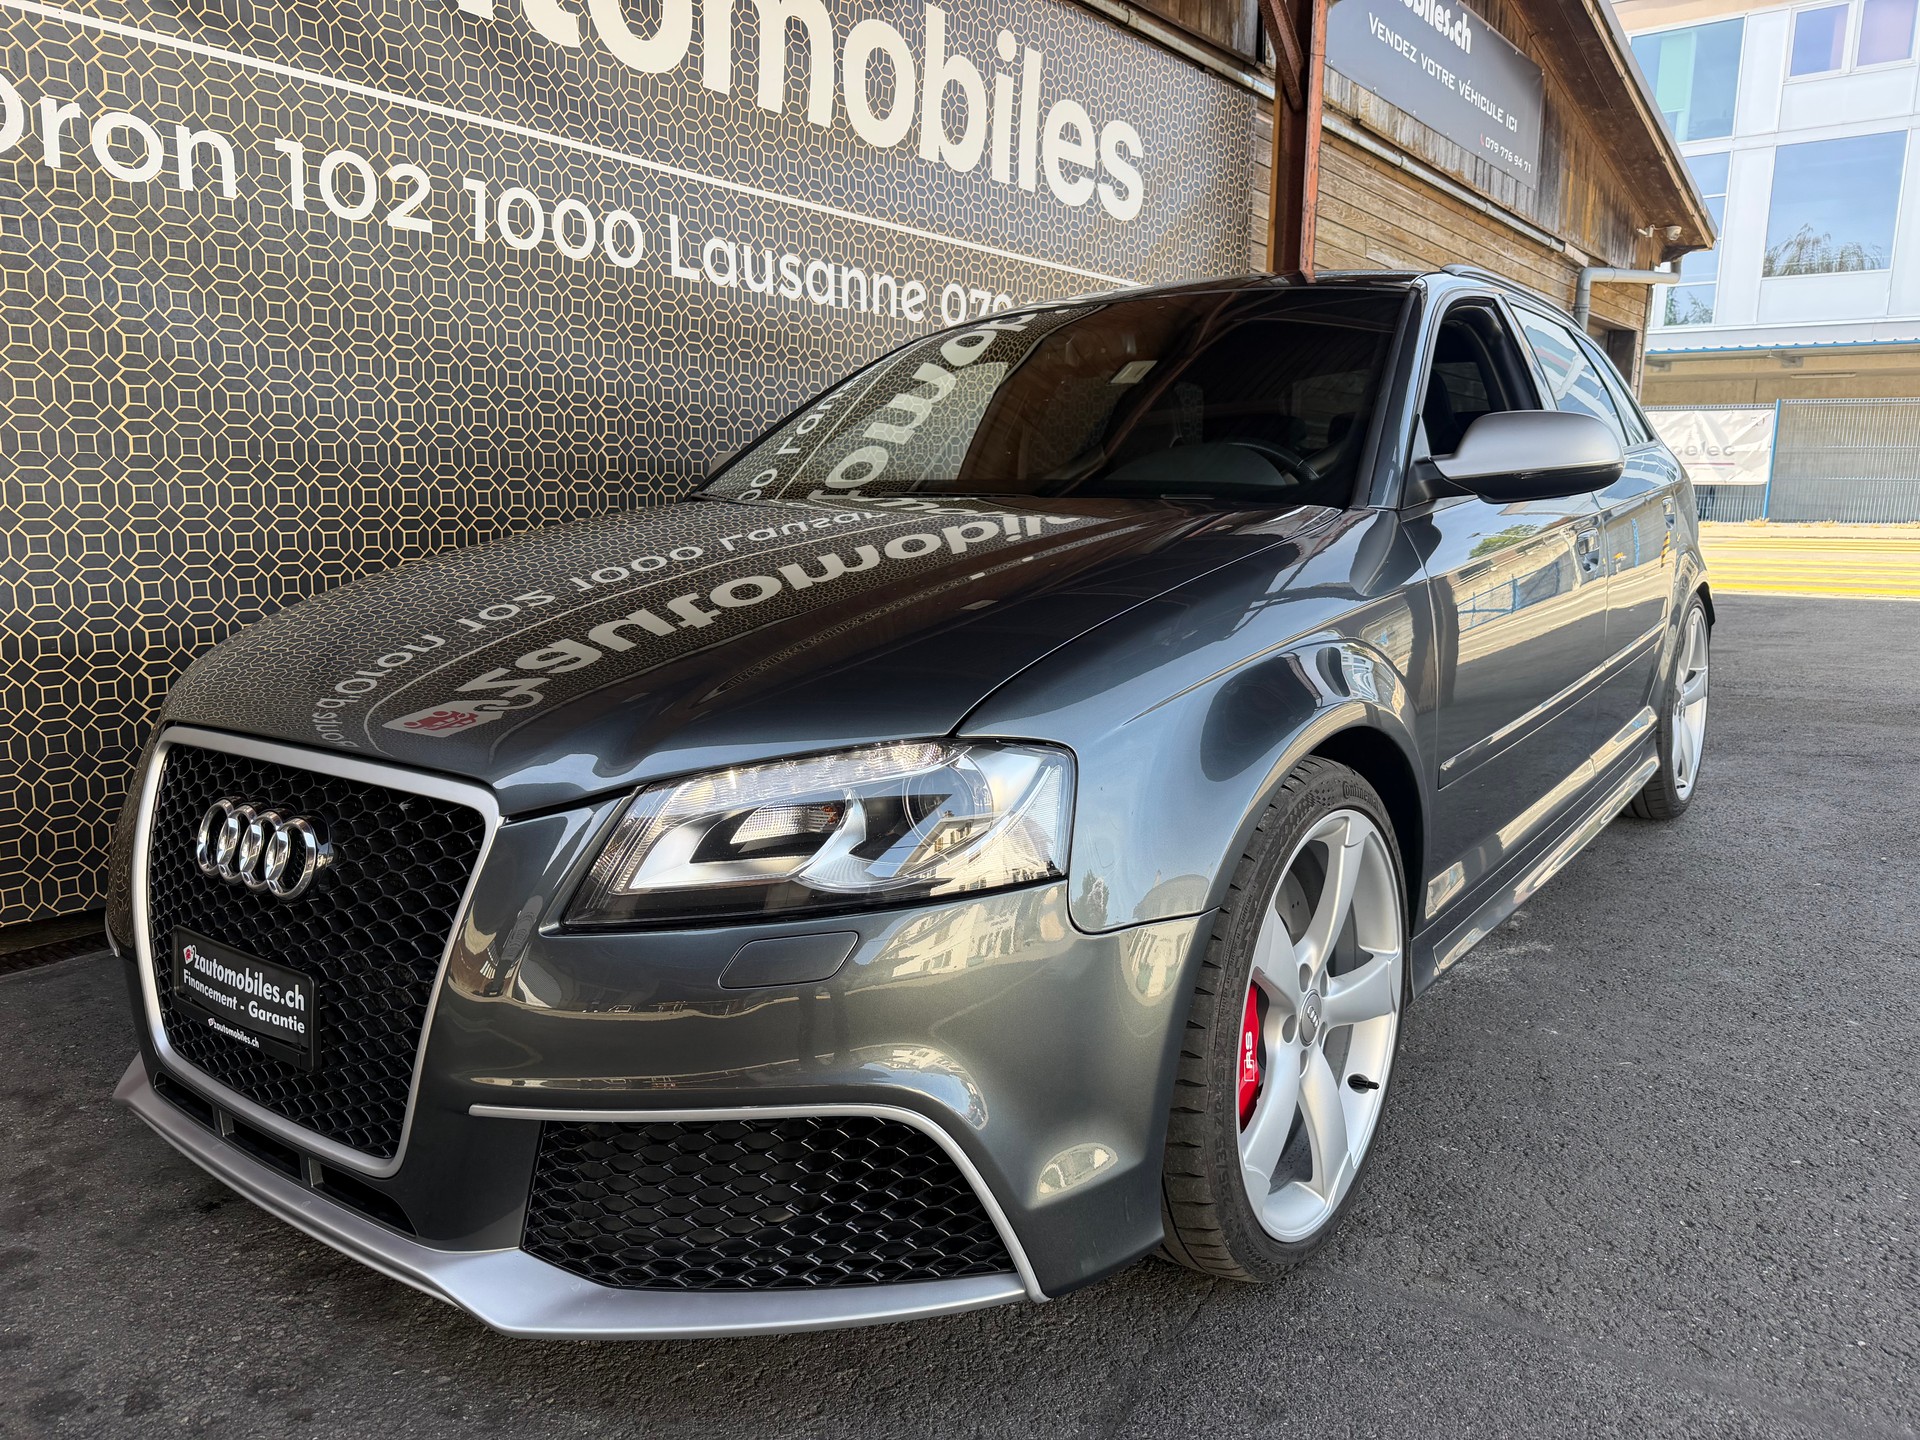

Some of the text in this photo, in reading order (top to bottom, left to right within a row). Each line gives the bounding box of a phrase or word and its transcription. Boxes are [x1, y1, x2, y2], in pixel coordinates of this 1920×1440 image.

[1368, 11, 1518, 133] VENDEZ VOTRE VÉHICULE ICI
[1485, 136, 1499, 153] 079
[1500, 145, 1513, 162] 776
[1523, 160, 1531, 174] 71
[0, 73, 238, 200] ron
[274, 137, 433, 234] 102
[462, 176, 645, 269] 1000
[669, 213, 926, 323] Lausanne
[183, 968, 238, 1011] Financement
[248, 1000, 306, 1034] Garantie
[193, 953, 306, 1012] zautomobiles.ch
[1245, 1031, 1253, 1069] RS
